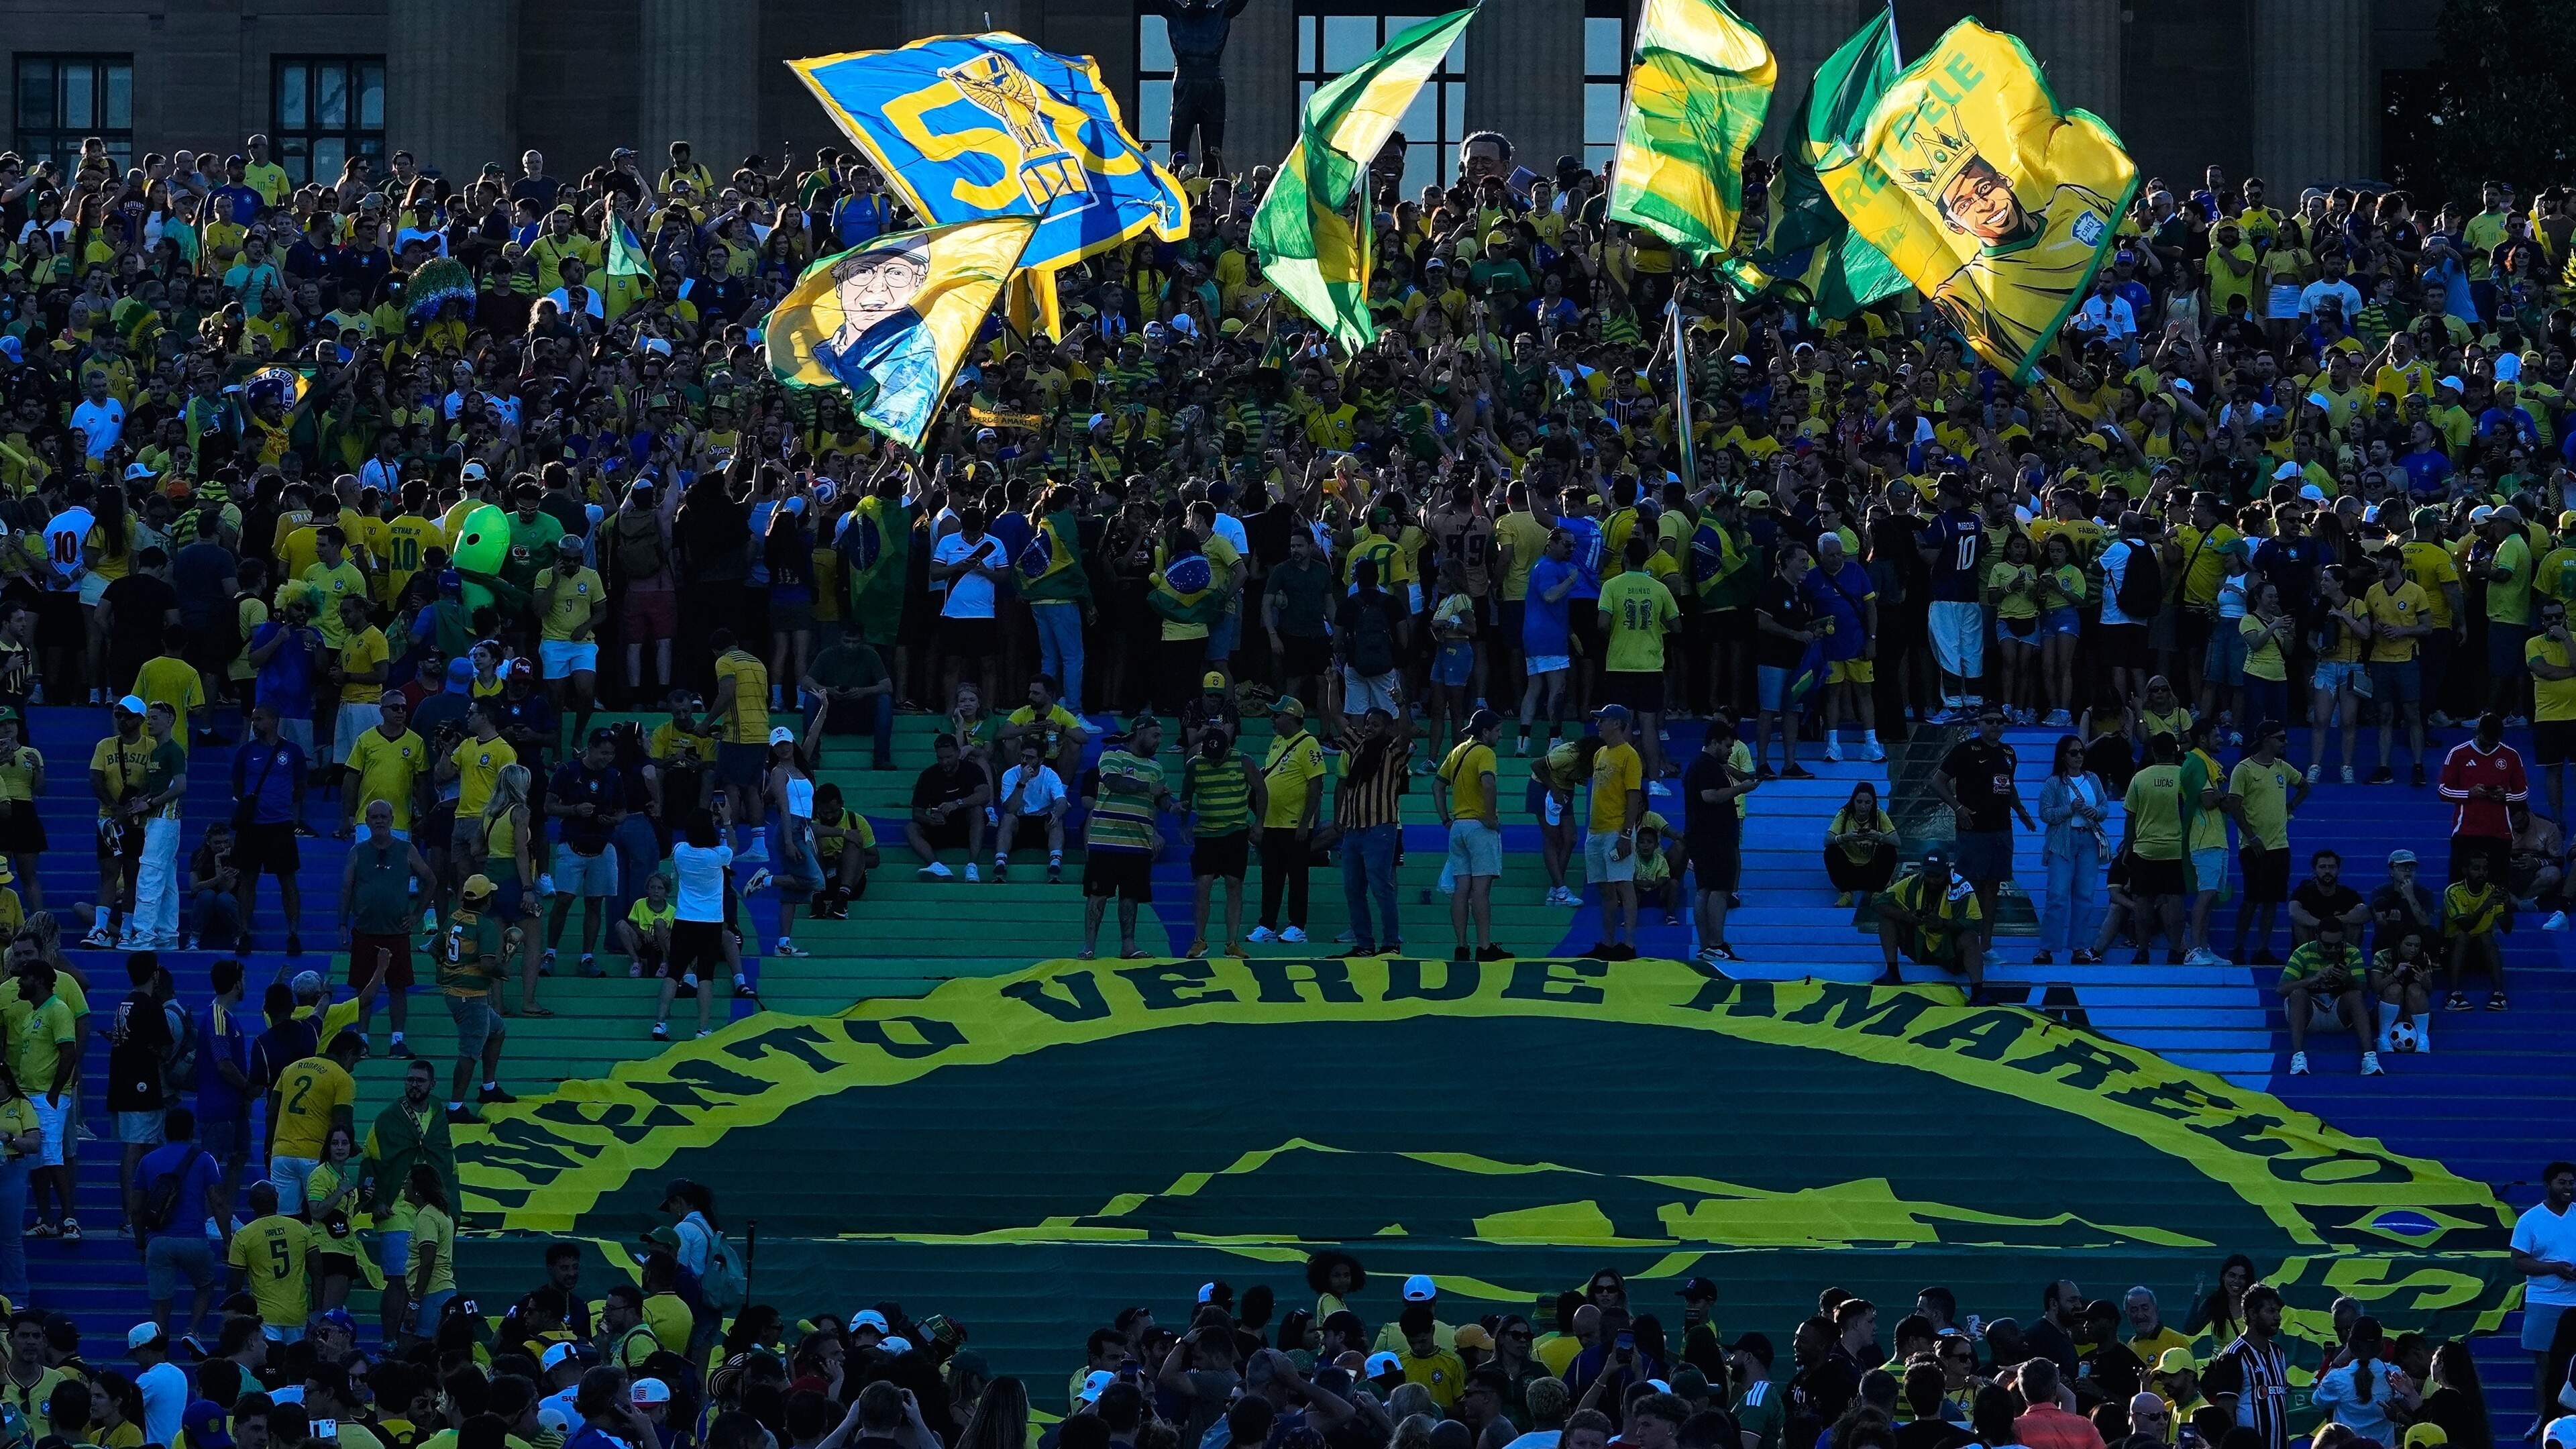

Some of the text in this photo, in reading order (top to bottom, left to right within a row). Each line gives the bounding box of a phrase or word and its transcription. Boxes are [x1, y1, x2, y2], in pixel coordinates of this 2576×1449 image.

[124, 201, 145, 211] HARVARD
[2082, 222, 2094, 237] CBD
[54, 531, 77, 564] 10
[391, 537, 417, 571] 10
[1957, 535, 1976, 570] 10
[566, 598, 572, 613] 9
[2153, 779, 2174, 788] LUCAS
[447, 938, 460, 962] 5
[1001, 959, 1605, 1023] VERDE
[1669, 980, 2414, 1184] AMARELO
[288, 1075, 313, 1115] 2
[270, 1238, 290, 1279] 5
